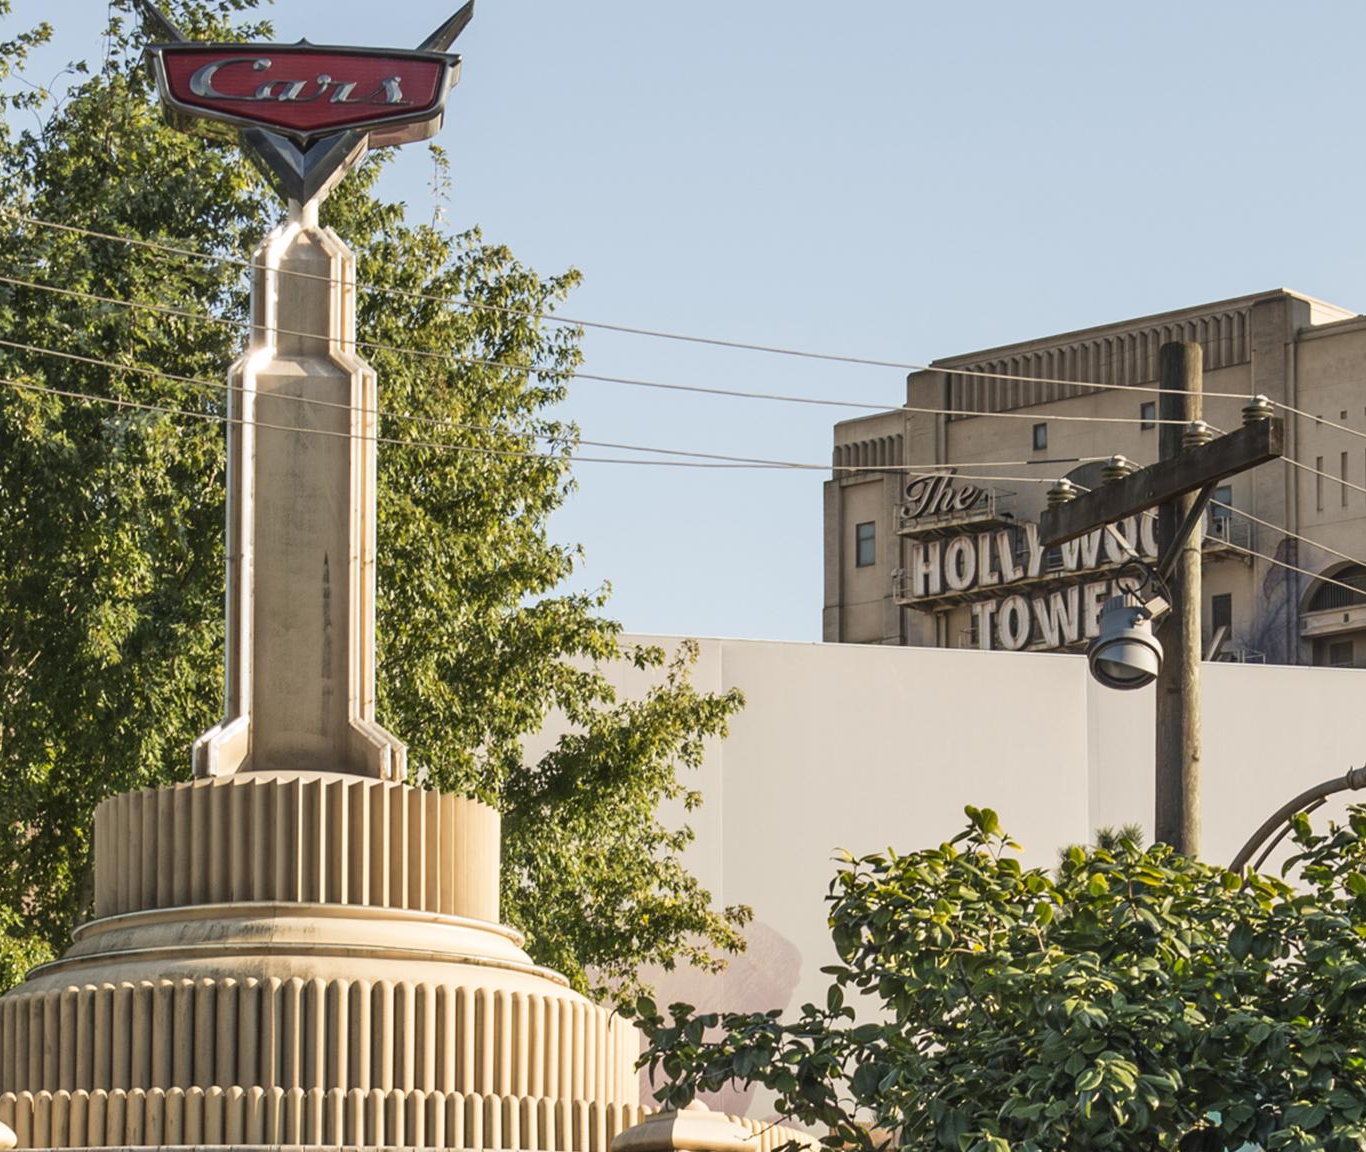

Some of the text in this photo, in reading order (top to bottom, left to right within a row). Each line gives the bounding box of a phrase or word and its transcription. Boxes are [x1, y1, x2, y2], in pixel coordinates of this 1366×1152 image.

[189, 56, 413, 105] Cars
[899, 467, 983, 520] The
[912, 506, 1208, 597] HOLLYWO
